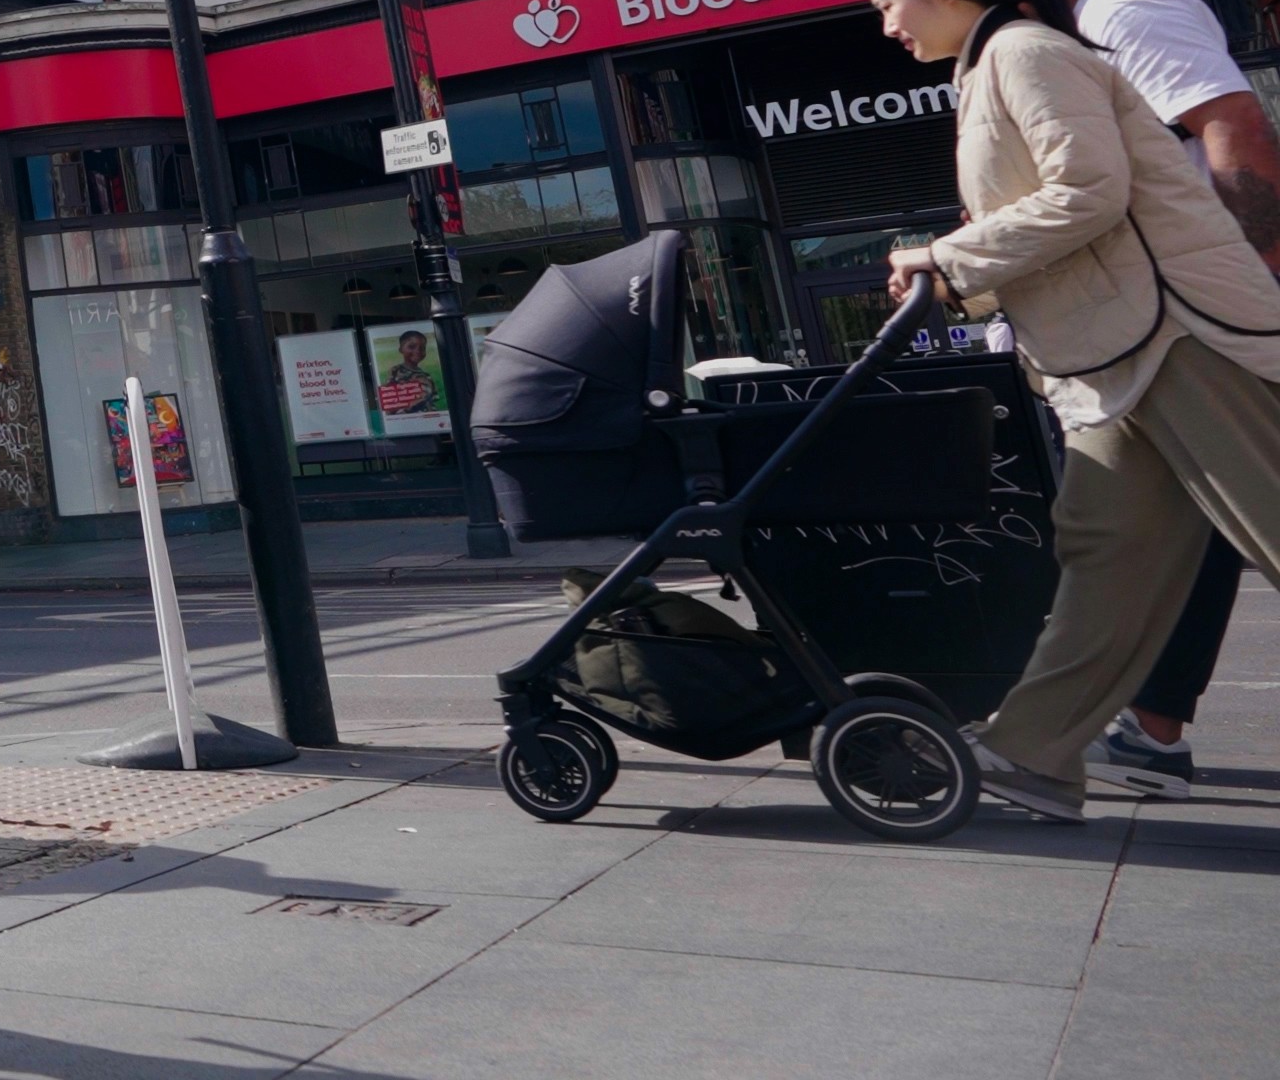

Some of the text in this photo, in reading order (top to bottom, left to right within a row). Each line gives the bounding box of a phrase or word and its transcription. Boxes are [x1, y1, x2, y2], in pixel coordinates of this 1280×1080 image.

[745, 82, 959, 138] Welcom
[393, 131, 416, 144] Traffic
[385, 140, 428, 156] enforcement
[393, 154, 423, 166] cameras
[296, 360, 332, 368] Brixton,
[299, 380, 326, 388] blood
[676, 528, 722, 538] nuna
